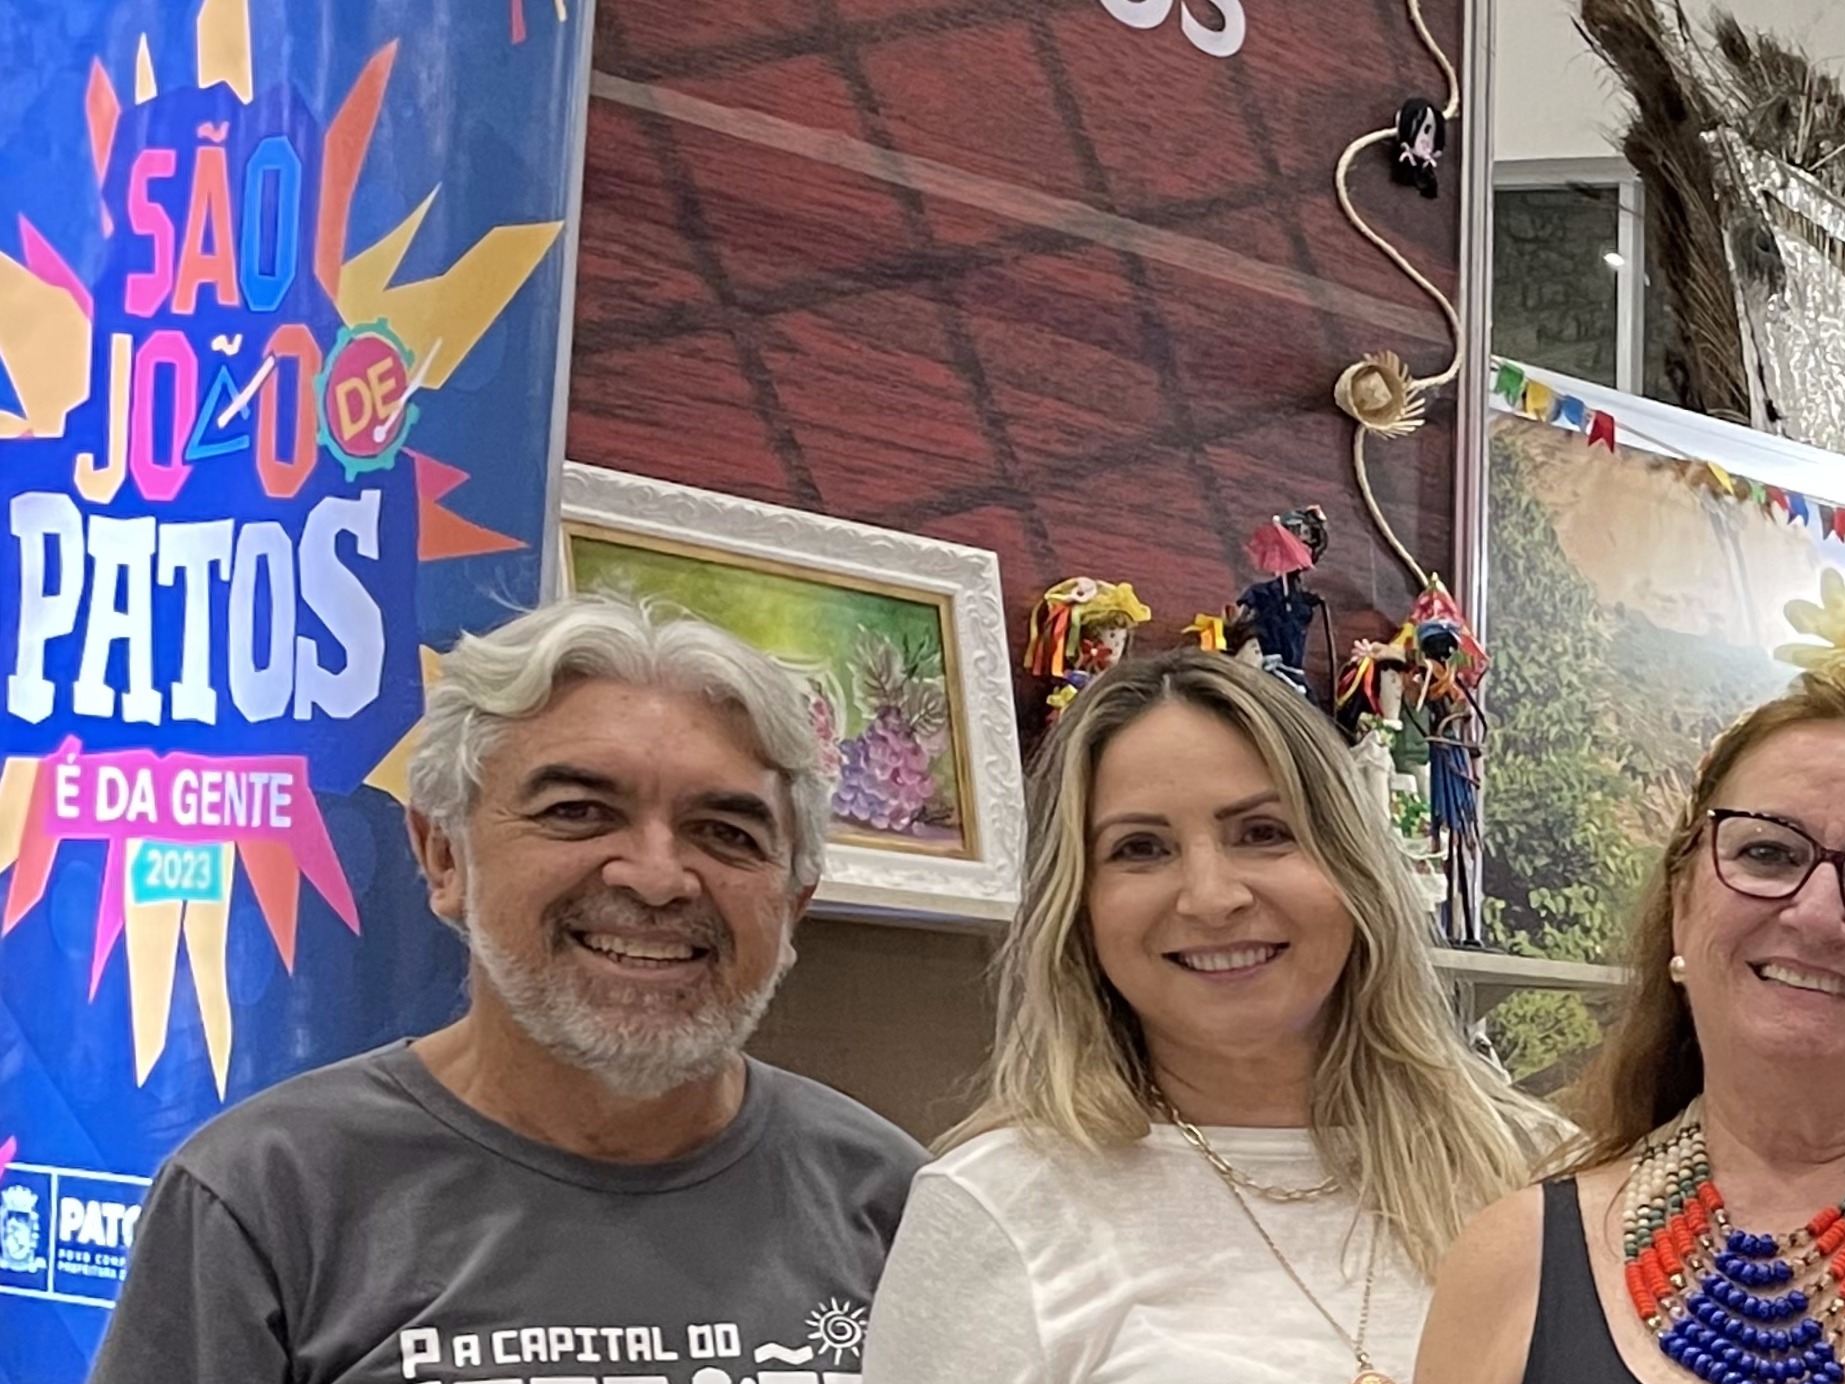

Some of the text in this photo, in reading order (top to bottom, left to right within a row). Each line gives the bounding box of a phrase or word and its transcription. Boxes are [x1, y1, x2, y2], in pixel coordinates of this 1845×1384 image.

[125, 121, 301, 314] SÃO
[73, 323, 403, 505] JOÃO DE
[7, 490, 385, 726] PATOS
[57, 753, 293, 828] É DA GENTE
[146, 850, 212, 891] 2023
[453, 1322, 742, 1368] A CAPITAL DO
